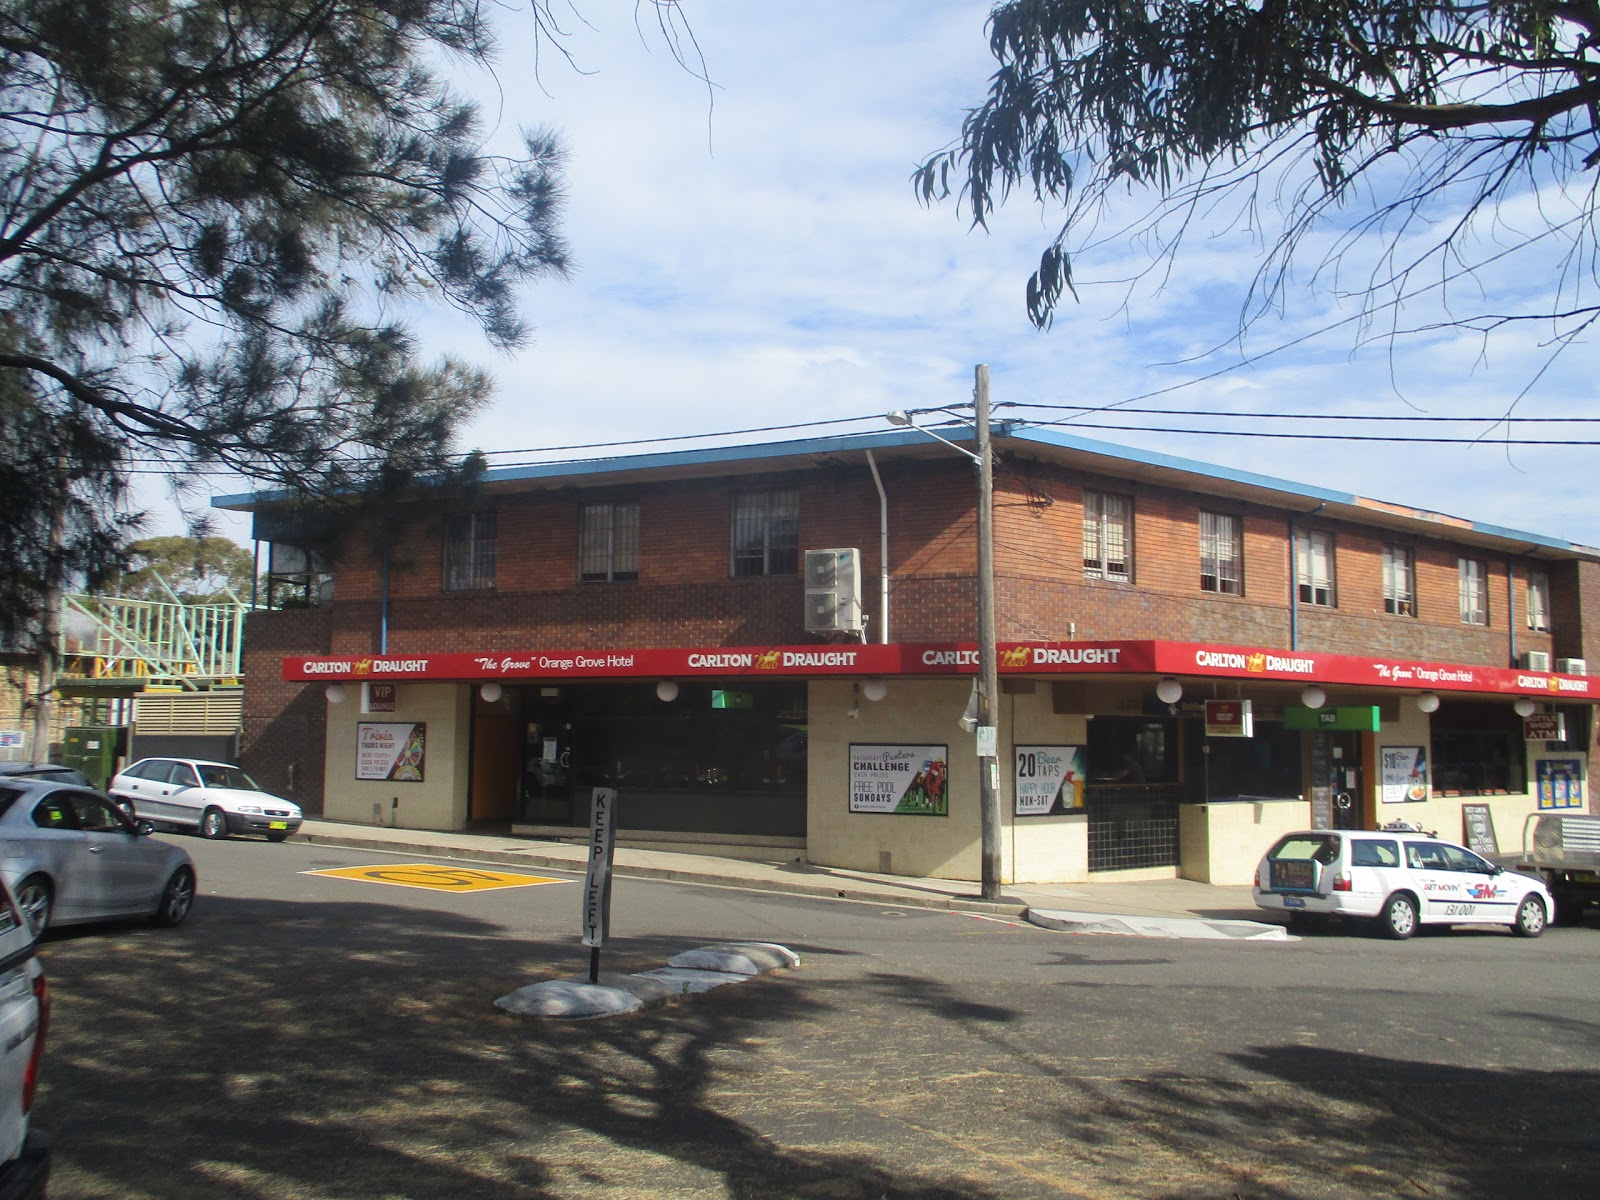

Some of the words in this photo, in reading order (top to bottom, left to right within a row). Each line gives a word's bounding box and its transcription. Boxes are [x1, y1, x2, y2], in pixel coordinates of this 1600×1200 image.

[539, 656, 573, 669] Orange
[575, 655, 605, 667] Grove
[607, 654, 634, 667] Hotel
[688, 653, 752, 667] CARLTON
[783, 652, 856, 666] DRAUGHT
[922, 650, 980, 665] CARLTO
[1033, 648, 1120, 664] DRAUGHT
[1195, 650, 1246, 669] CARLTON
[1266, 655, 1314, 673] DRAUGHT
[303, 661, 351, 674] CARLTON
[373, 660, 428, 673] DRAUGHT
[1416, 667, 1438, 682] Orange
[1439, 668, 1456, 681] Grove
[1457, 670, 1473, 682] Hotel
[1518, 675, 1547, 689] CARLTON
[1558, 678, 1588, 692] DRAUGHT
[375, 686, 391, 698] VIP
[370, 702, 395, 710] LOUNGE
[1320, 714, 1335, 722] TAB
[1529, 730, 1556, 739] ATM
[882, 750, 916, 762] Punters
[854, 762, 909, 771] CHALLENGE
[1019, 753, 1036, 777] 20
[1037, 751, 1062, 765] Beer
[1038, 765, 1060, 777] TAPS
[854, 781, 873, 792] FREE
[877, 781, 896, 793] POOL
[1020, 783, 1037, 794] HAPPY
[1041, 783, 1056, 794] HOUR
[854, 793, 891, 802] SUNDAYS
[1020, 795, 1048, 806] MON-SAT
[593, 794, 606, 861] KEEP
[1424, 883, 1438, 891] GET
[588, 873, 600, 940] LEFT
